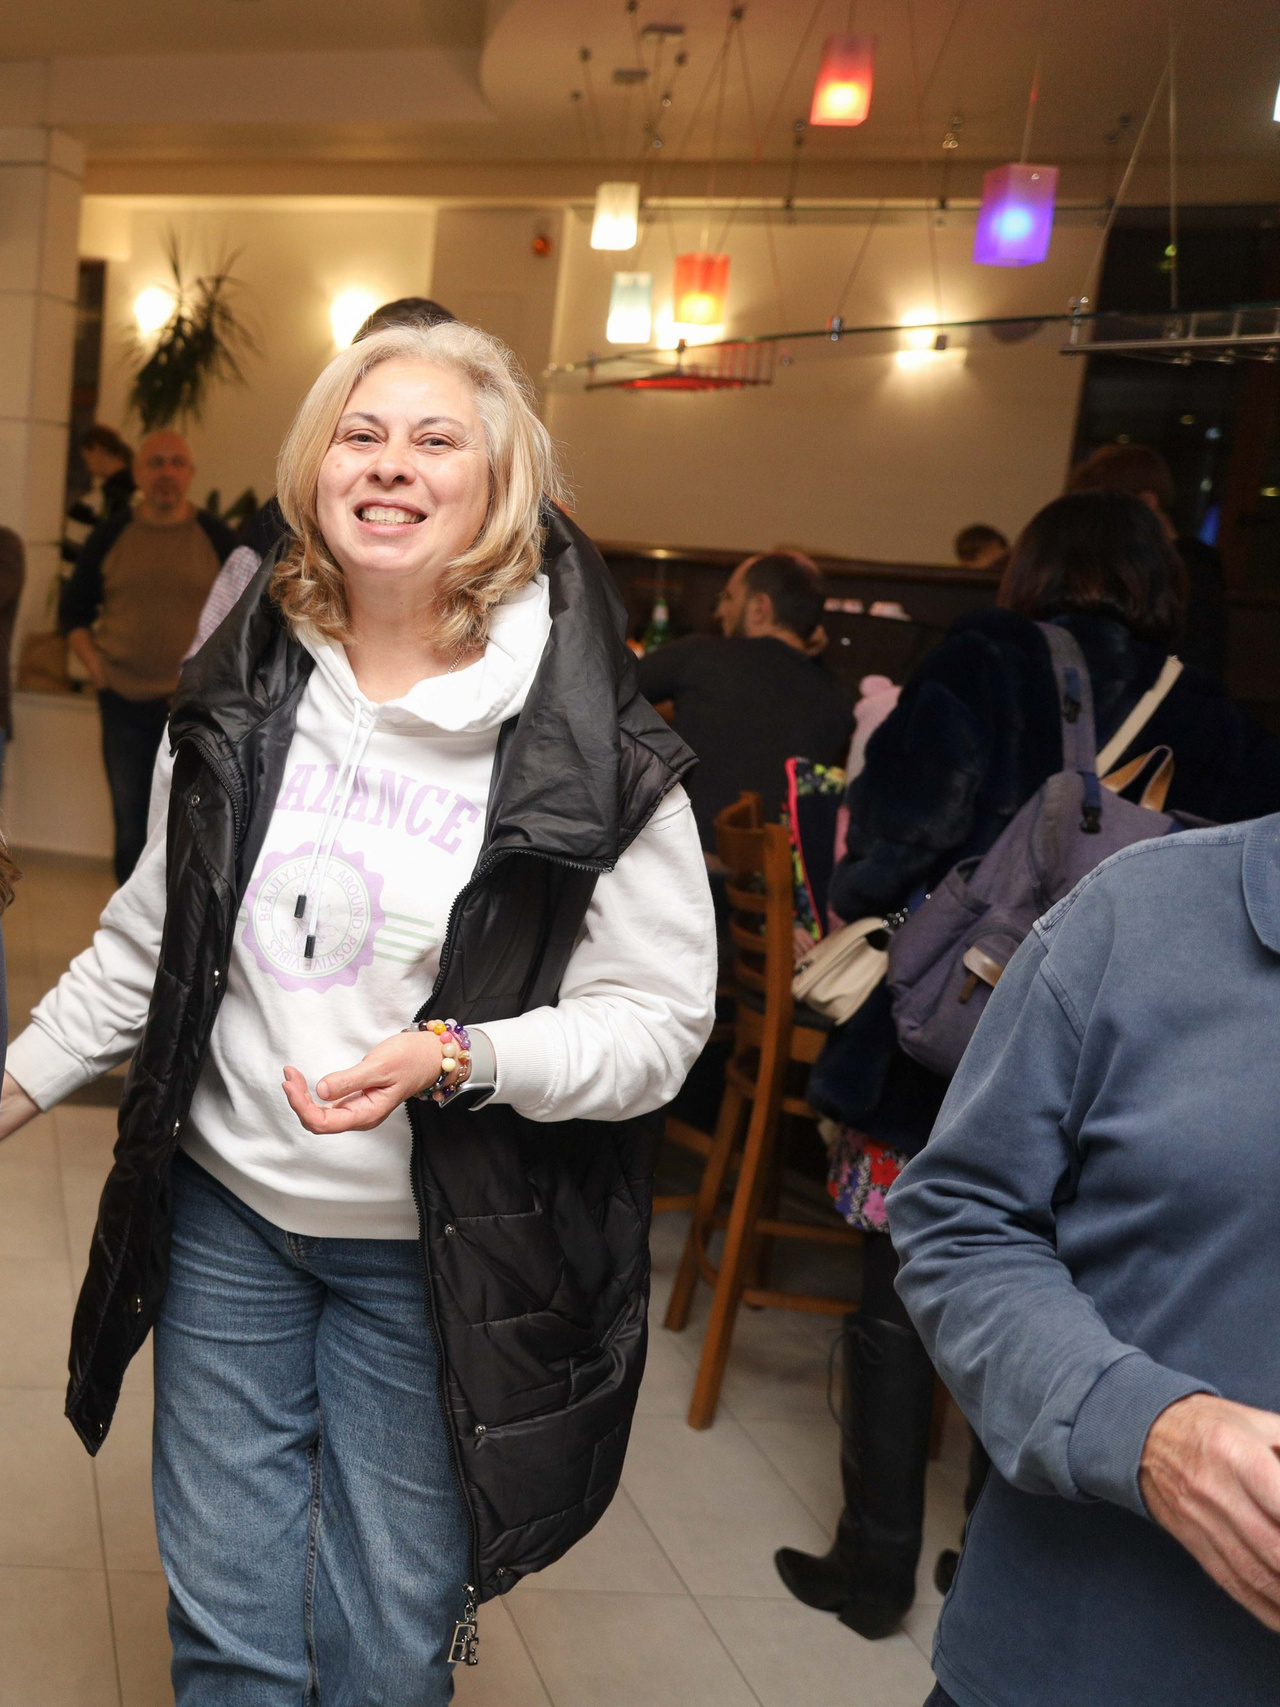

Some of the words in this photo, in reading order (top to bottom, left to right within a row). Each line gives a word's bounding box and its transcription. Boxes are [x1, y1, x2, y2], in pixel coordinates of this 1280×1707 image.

[275, 763, 482, 856] ALANCE
[259, 868, 290, 922] BEAUTY
[294, 863, 307, 875] IS
[313, 860, 334, 875] AL
[304, 934, 358, 971] POSITIVE
